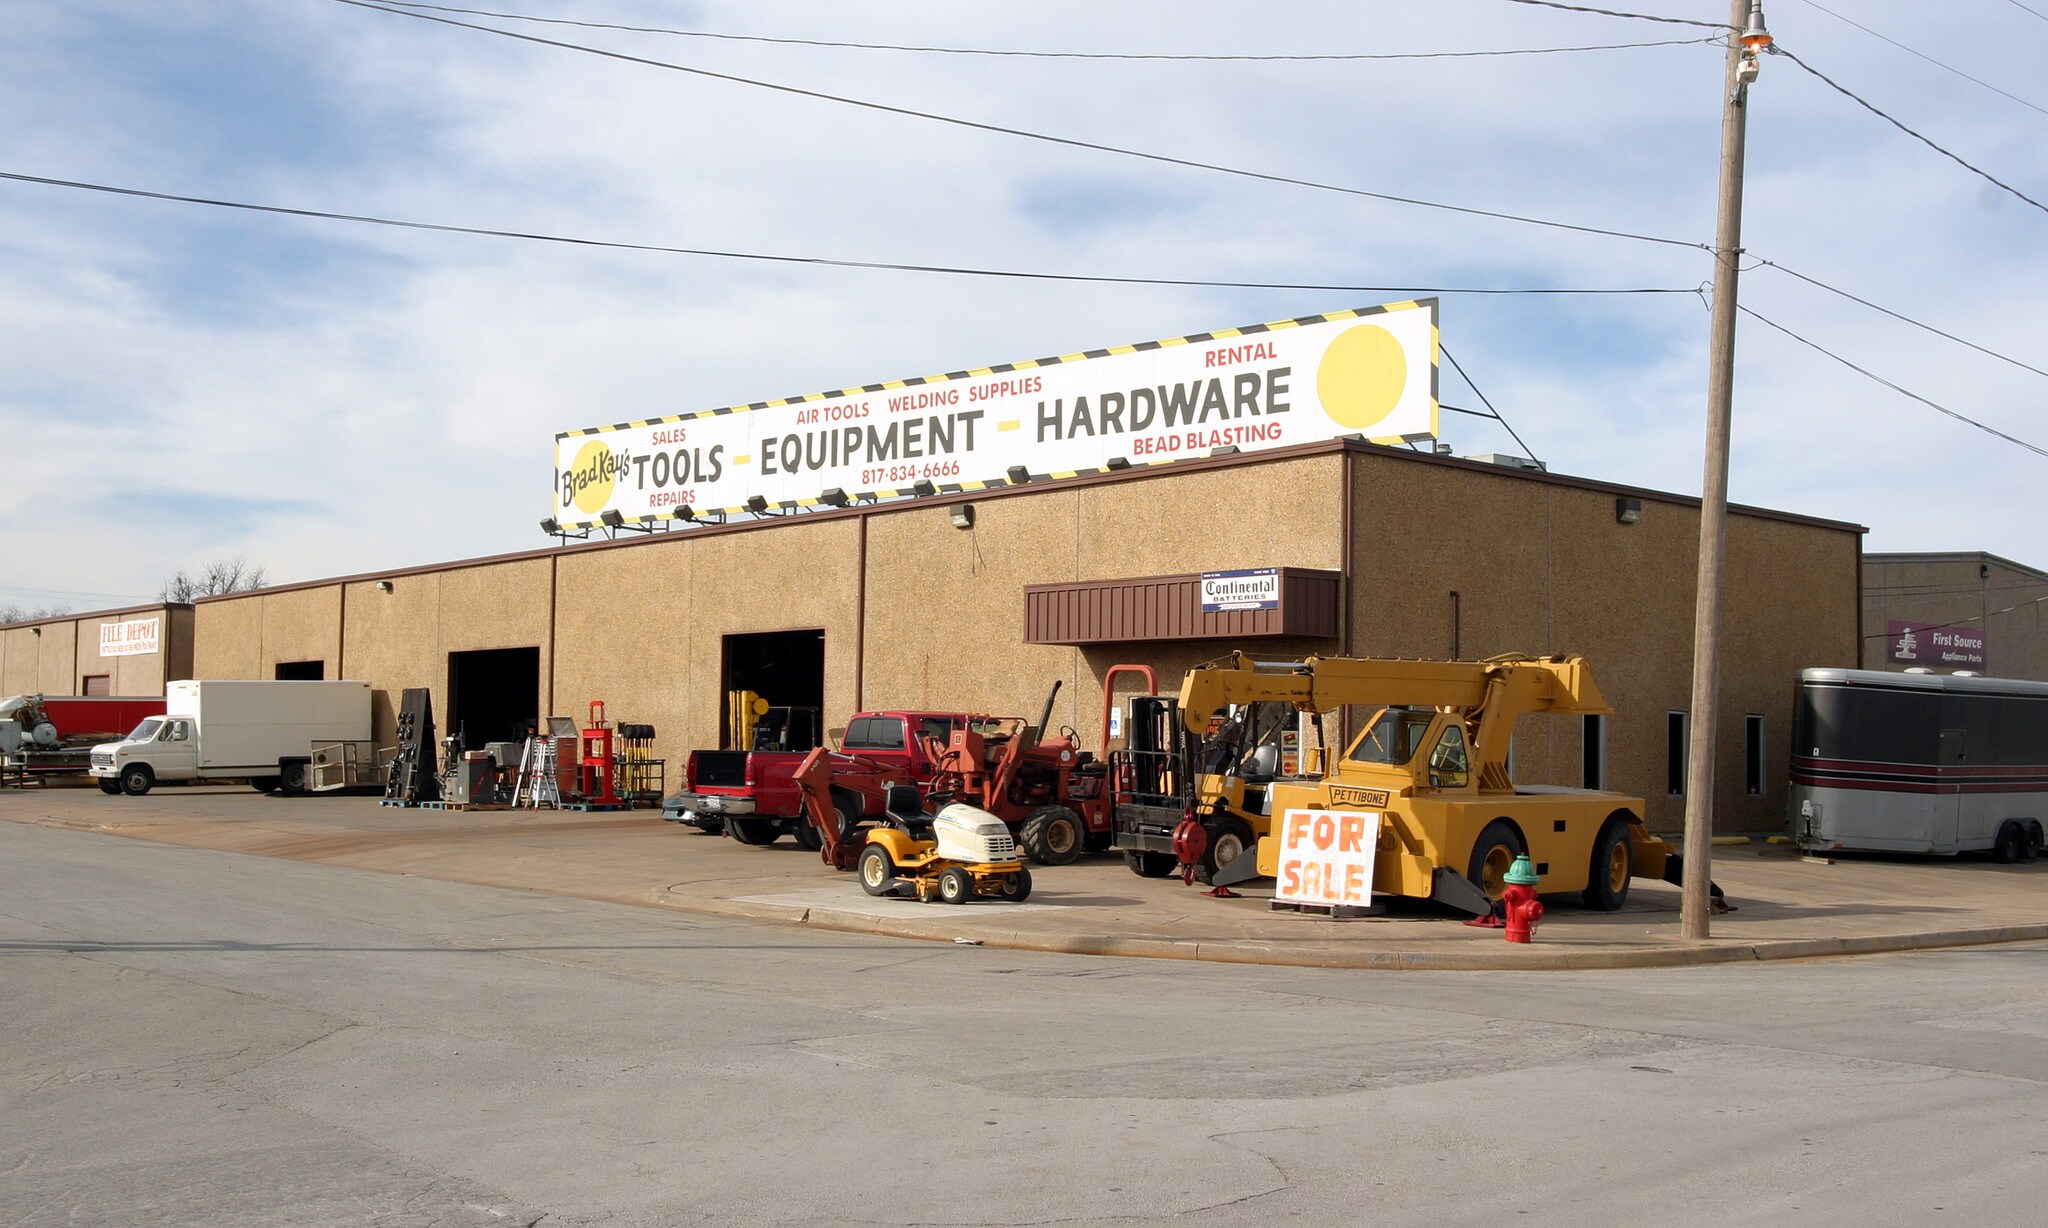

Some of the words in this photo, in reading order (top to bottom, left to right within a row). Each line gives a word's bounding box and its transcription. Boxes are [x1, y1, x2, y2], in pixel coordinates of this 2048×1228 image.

[1204, 341, 1278, 368] RENTAL
[887, 389, 960, 413] WELDING
[968, 375, 1043, 402] SUPPLIES
[796, 407, 820, 425] AIR
[823, 402, 870, 422] TOOLS
[632, 444, 724, 490] TOOLS
[760, 410, 985, 476] EQUIPMENT
[1036, 365, 1292, 443] HARDWARE
[652, 428, 687, 446] SALES
[1132, 433, 1182, 456] BEAD
[1186, 421, 1283, 451] BLASTING
[561, 455, 598, 508] Brad
[598, 447, 630, 485] Kay's
[649, 489, 696, 508] REPAIRS
[1205, 576, 1275, 596] Continental
[1213, 593, 1267, 603] BATTERIES
[126, 620, 157, 641] DEPOT
[1933, 632, 1952, 646] First
[1953, 634, 1982, 649] Source
[1942, 651, 1968, 662] Appliance
[1968, 654, 1982, 663] Parts
[1333, 789, 1386, 805] PETTIBONE
[1287, 813, 1365, 853] FOR
[1282, 859, 1365, 901] SALE
